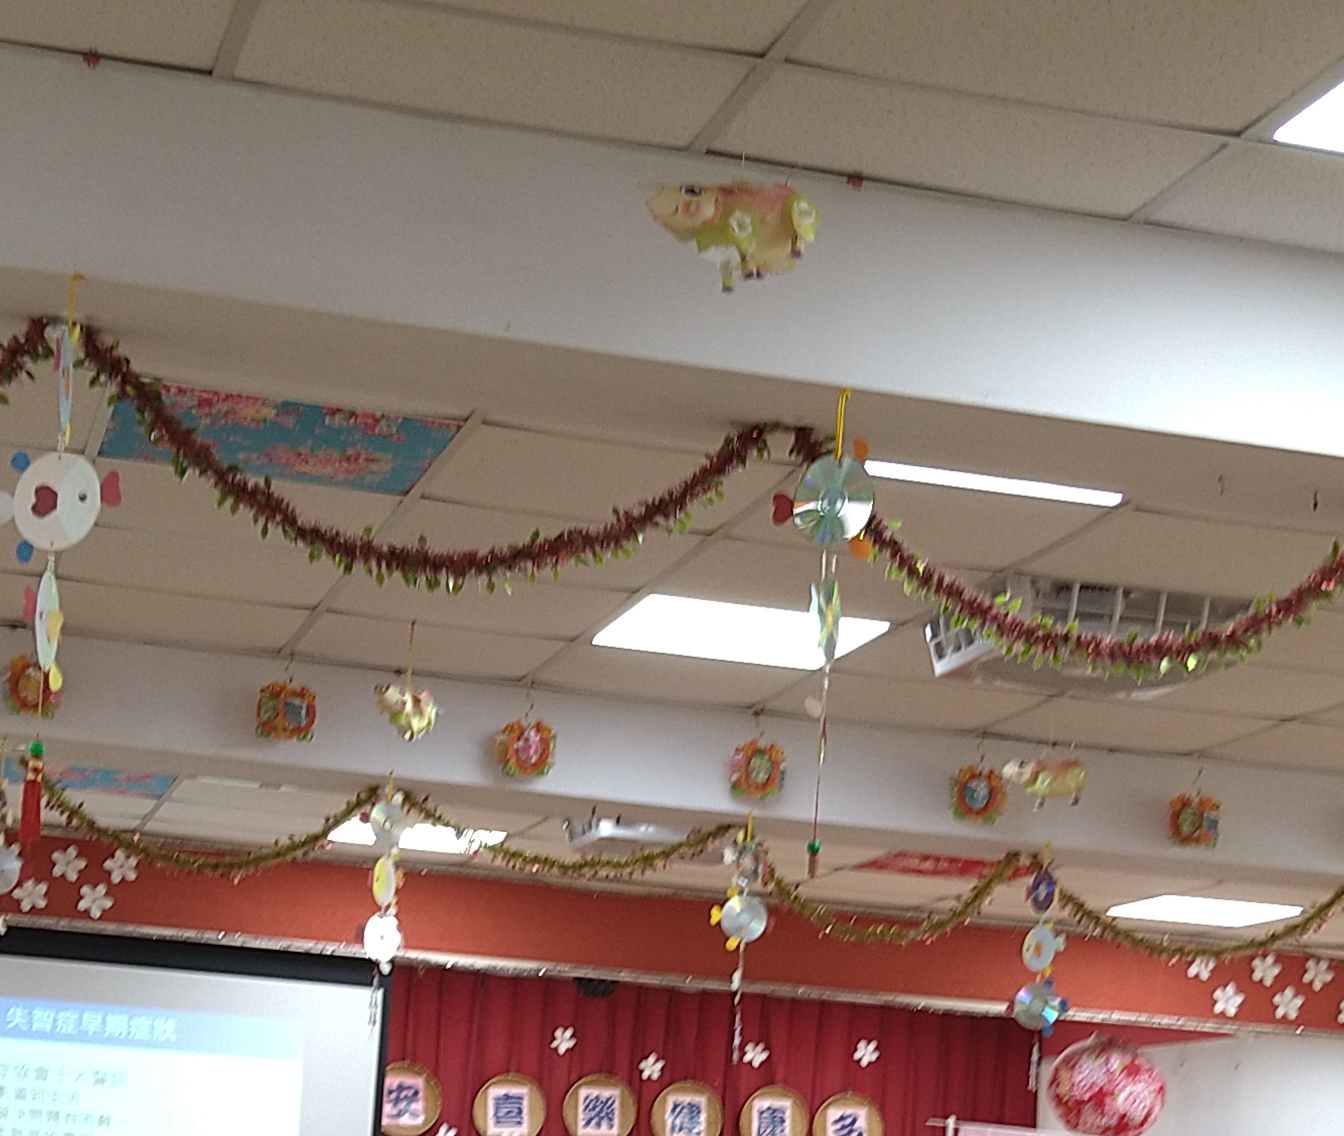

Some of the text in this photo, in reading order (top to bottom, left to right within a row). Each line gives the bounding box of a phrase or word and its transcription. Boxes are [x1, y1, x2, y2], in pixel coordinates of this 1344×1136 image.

[5, 1005, 178, 1043] 失智症早期症狀
